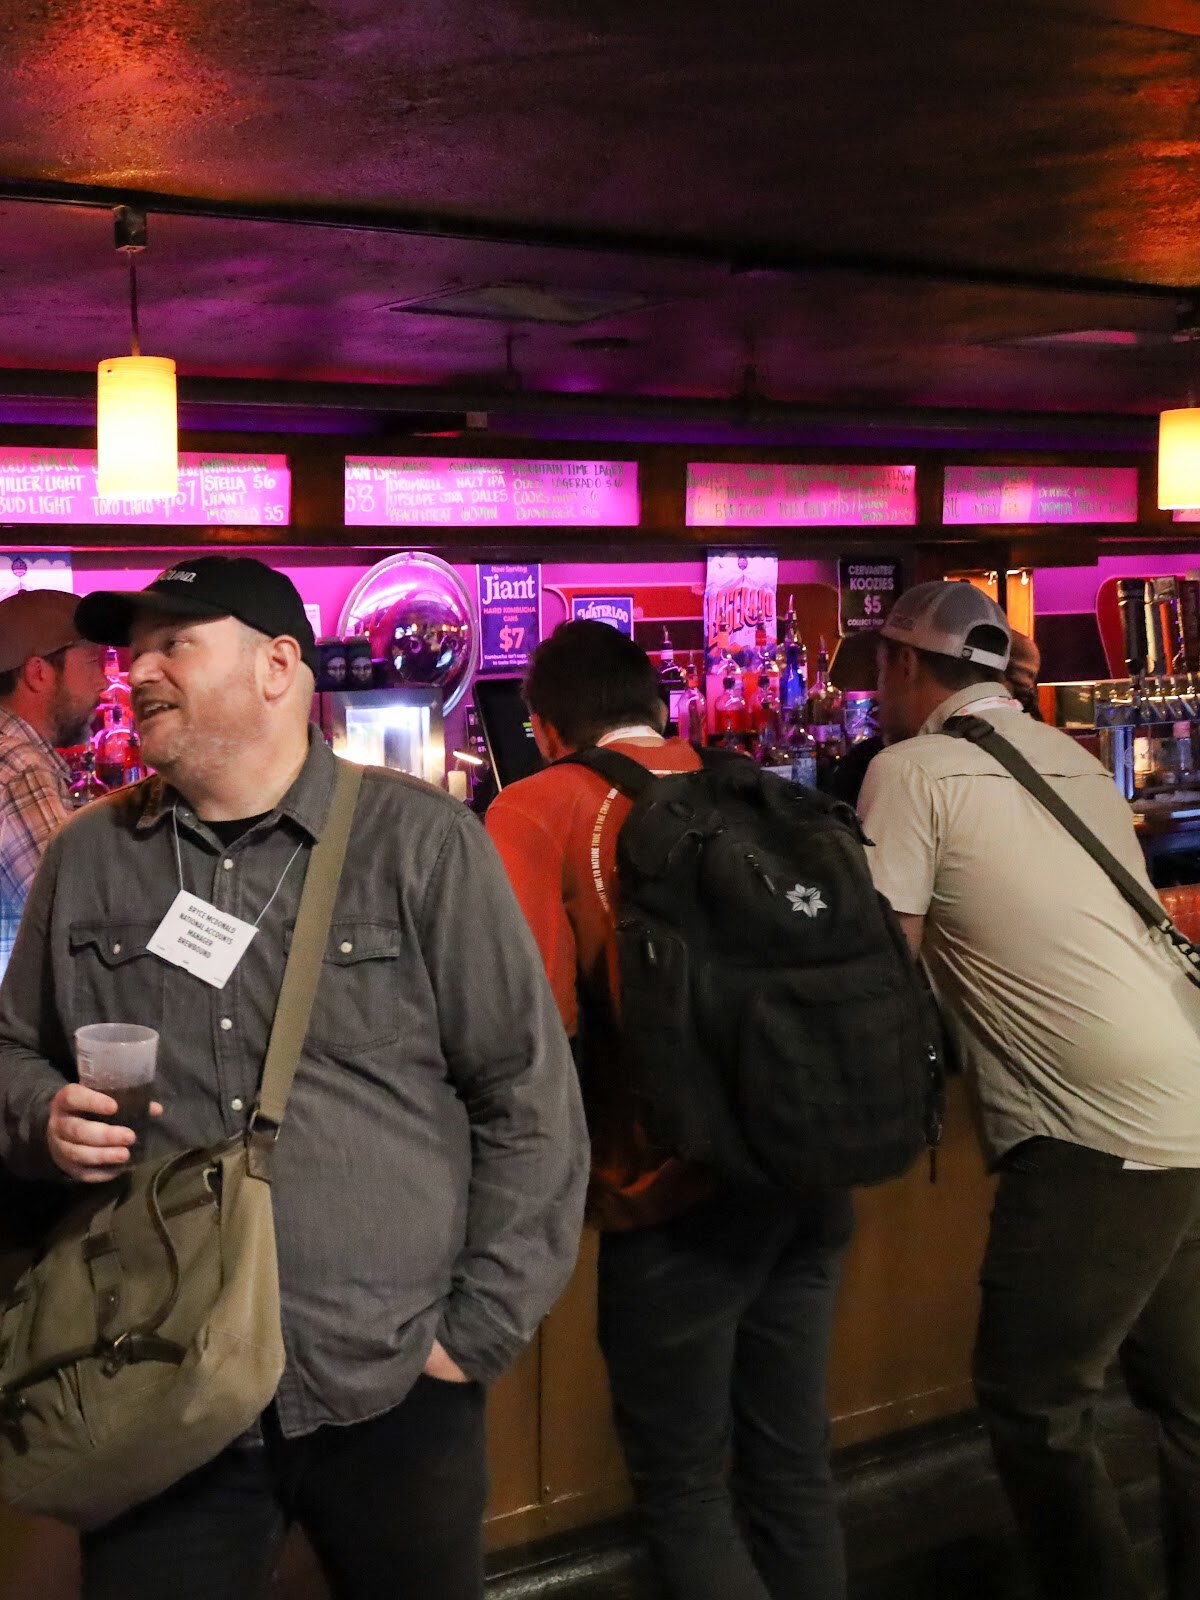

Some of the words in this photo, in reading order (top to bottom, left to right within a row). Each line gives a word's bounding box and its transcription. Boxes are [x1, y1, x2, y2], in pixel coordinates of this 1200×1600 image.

[46, 475, 86, 492] LIGHT
[204, 475, 246, 492] STELLA
[253, 474, 276, 492] $6
[28, 495, 76, 515] LIGHT
[264, 502, 284, 522] $5
[482, 573, 536, 605] Jiant
[850, 577, 894, 590] KOOZIES
[577, 601, 628, 623] WATERLOO
[864, 594, 881, 615] $5
[500, 624, 525, 652] $7
[591, 832, 601, 847] TRUE
[591, 847, 600, 869] NATURE
[180, 913, 205, 930] NATIONAL
[205, 927, 234, 945] ACCOUNTS
[188, 905, 206, 917] BRYCE
[206, 915, 236, 934] MCDONALD
[187, 929, 213, 946] MANAGER
